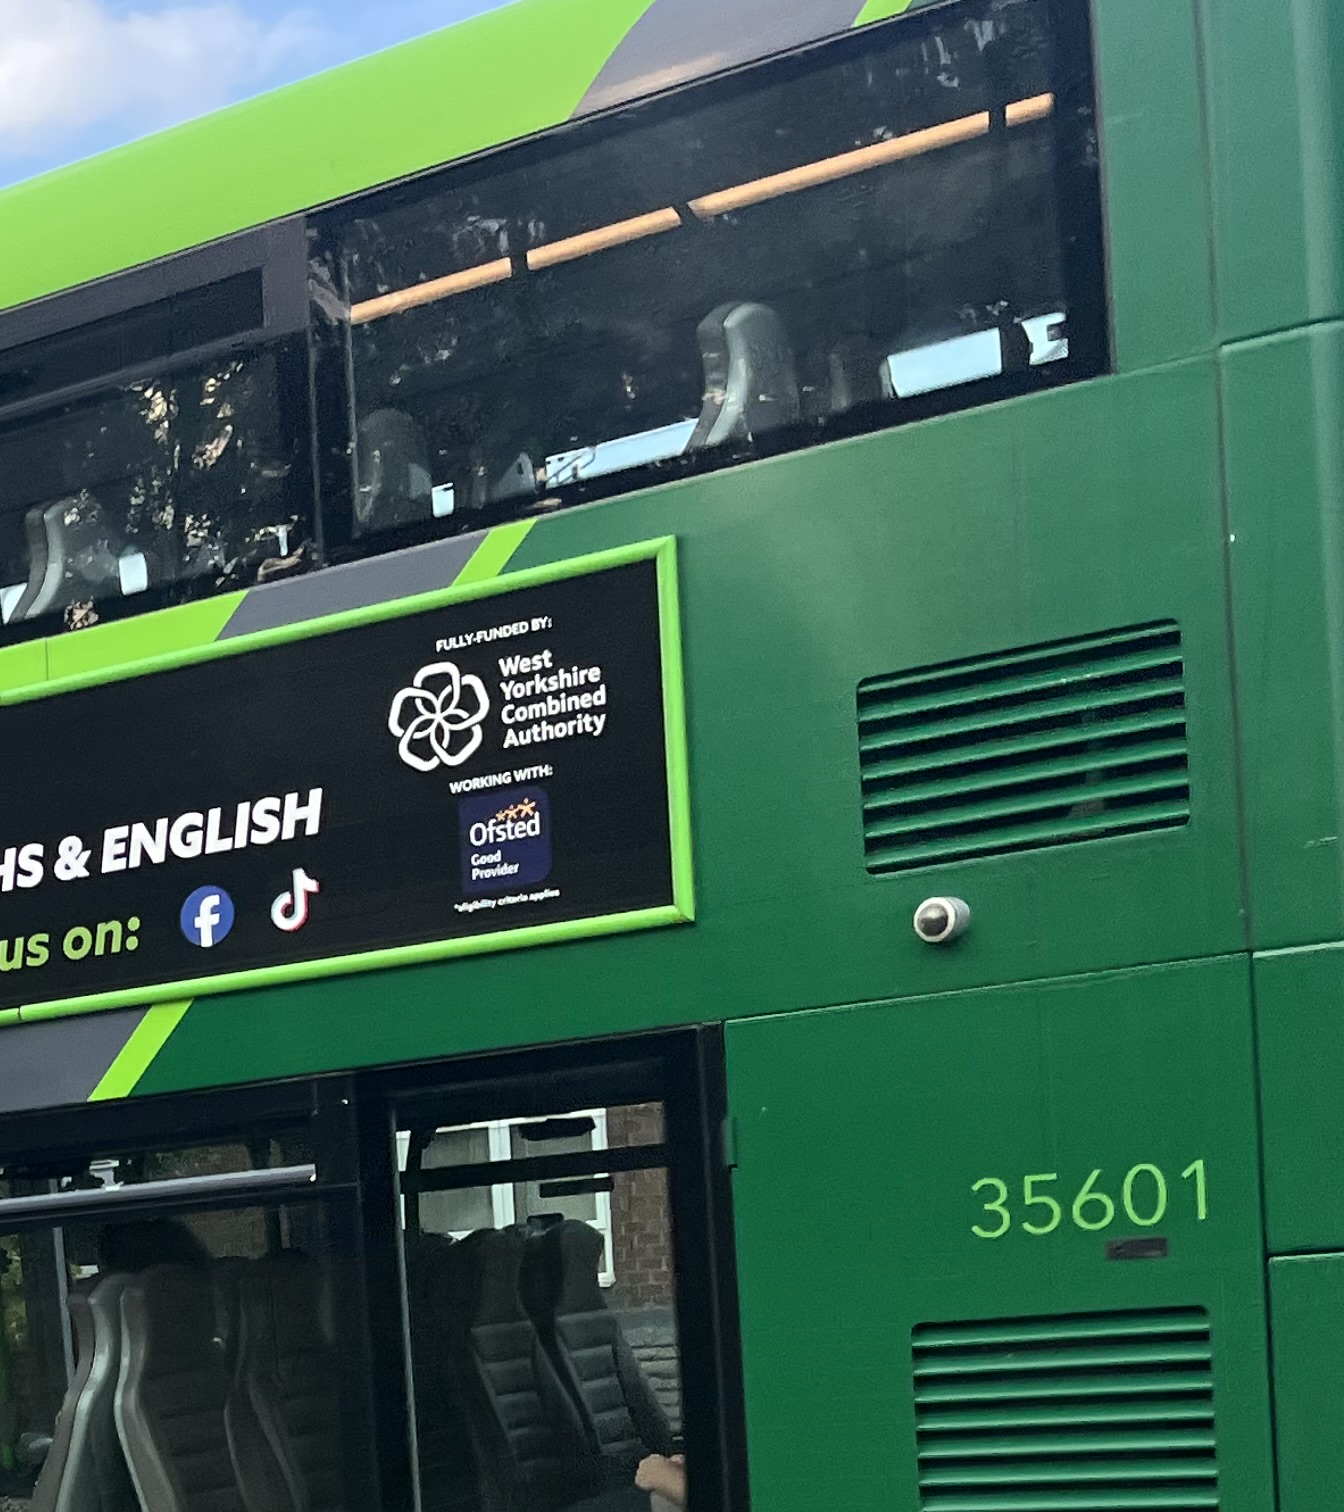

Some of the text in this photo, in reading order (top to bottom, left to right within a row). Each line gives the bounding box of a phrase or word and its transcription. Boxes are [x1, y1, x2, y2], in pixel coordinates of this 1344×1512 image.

[435, 615, 553, 653] FULLY-FUNDED BY:
[499, 649, 553, 677] West
[500, 664, 601, 701] Yorkshire
[502, 684, 607, 725] Combined
[503, 713, 607, 748] Authority
[449, 764, 553, 794] WORKING WITH:
[53, 835, 92, 881] &
[100, 787, 323, 874] ENGLISH
[469, 811, 541, 847] Ofsted
[470, 850, 502, 867] Good
[471, 862, 520, 881] Provider
[62, 915, 141, 960] on:
[971, 1159, 1208, 1239] 35601
